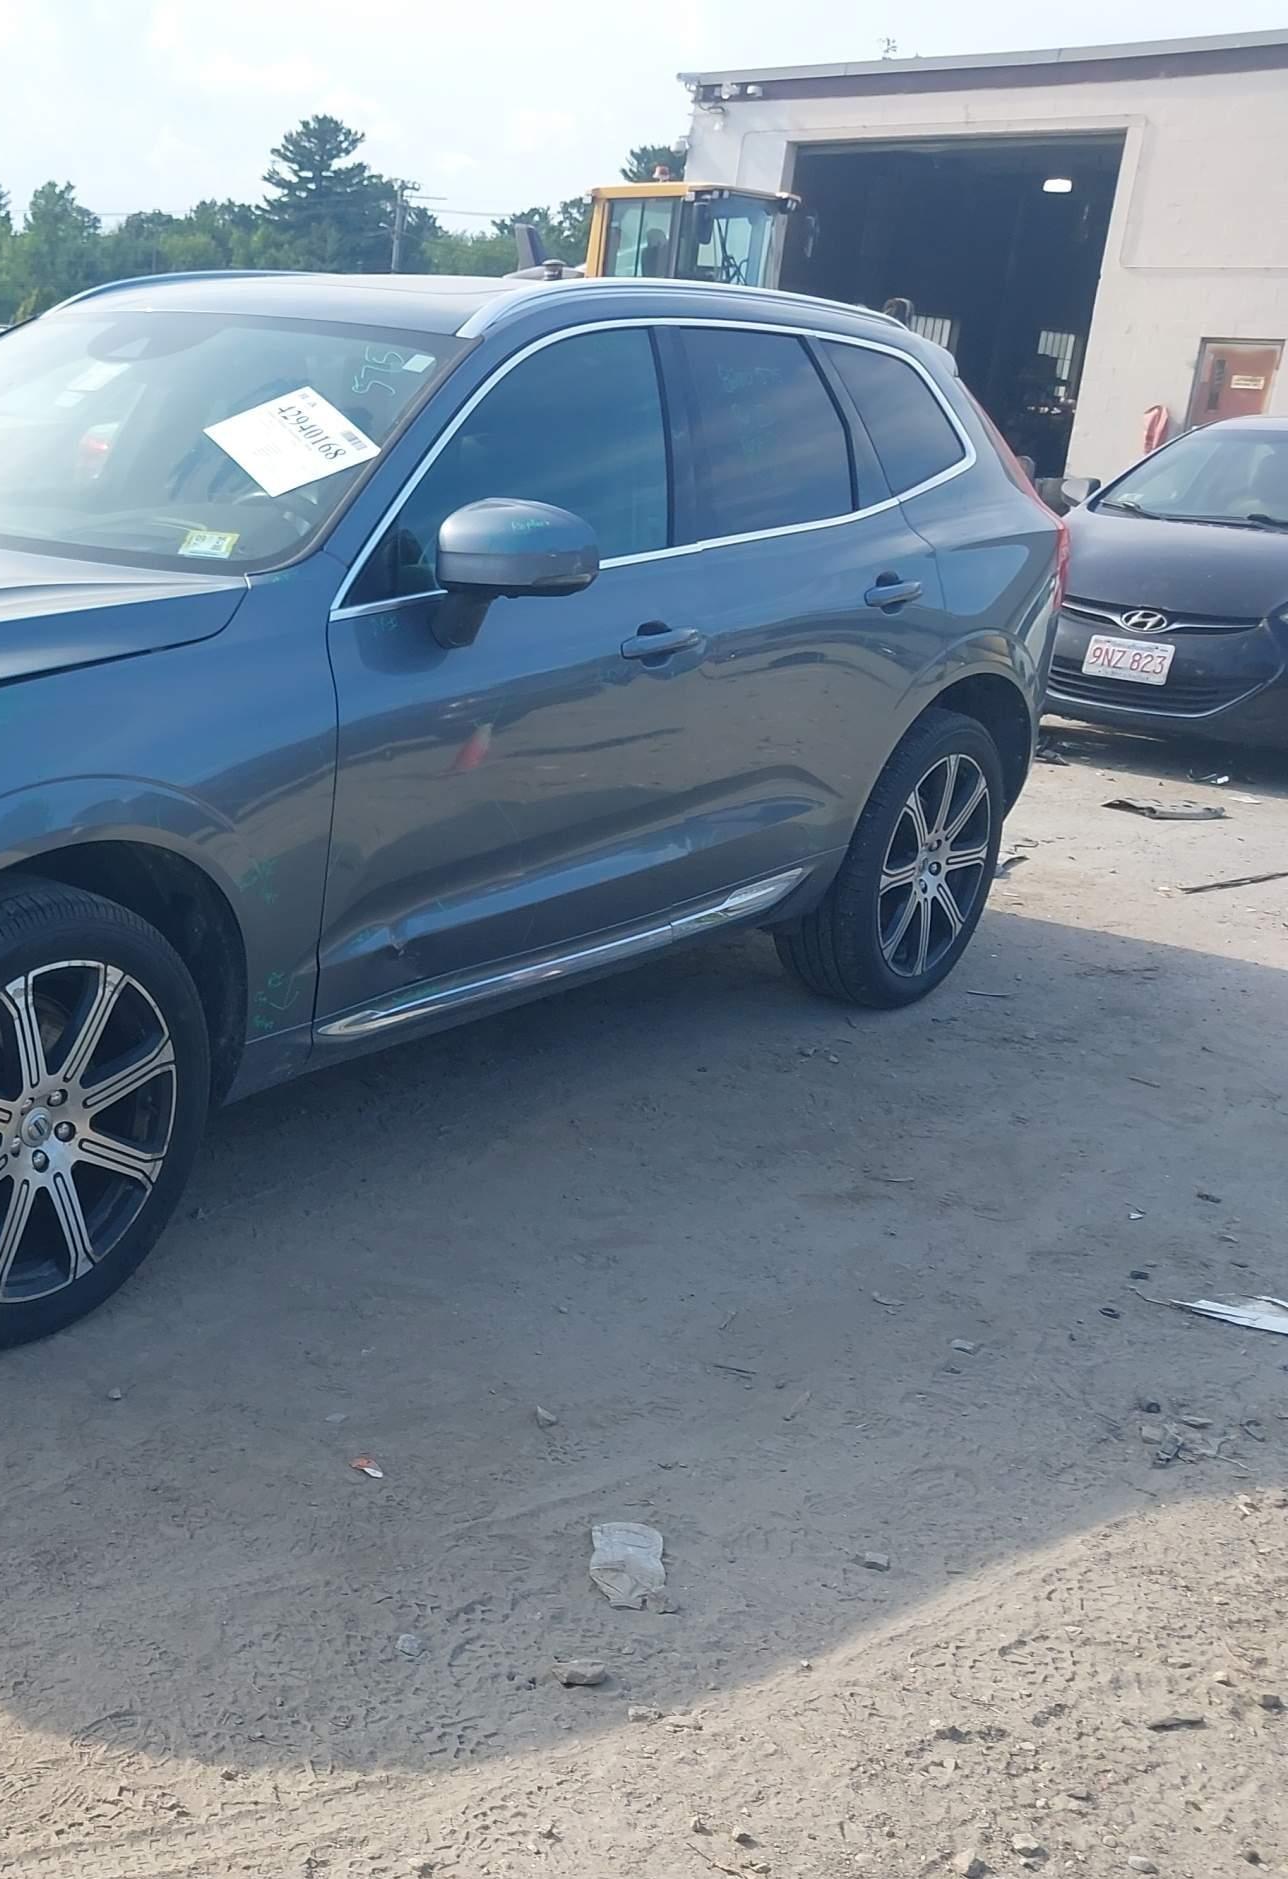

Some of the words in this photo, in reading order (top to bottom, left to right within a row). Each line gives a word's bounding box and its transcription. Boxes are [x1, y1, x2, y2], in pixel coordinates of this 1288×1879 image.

[278, 405, 346, 460] 42940168
[1089, 647, 1127, 669] 9NZ
[1130, 652, 1167, 675] 823
